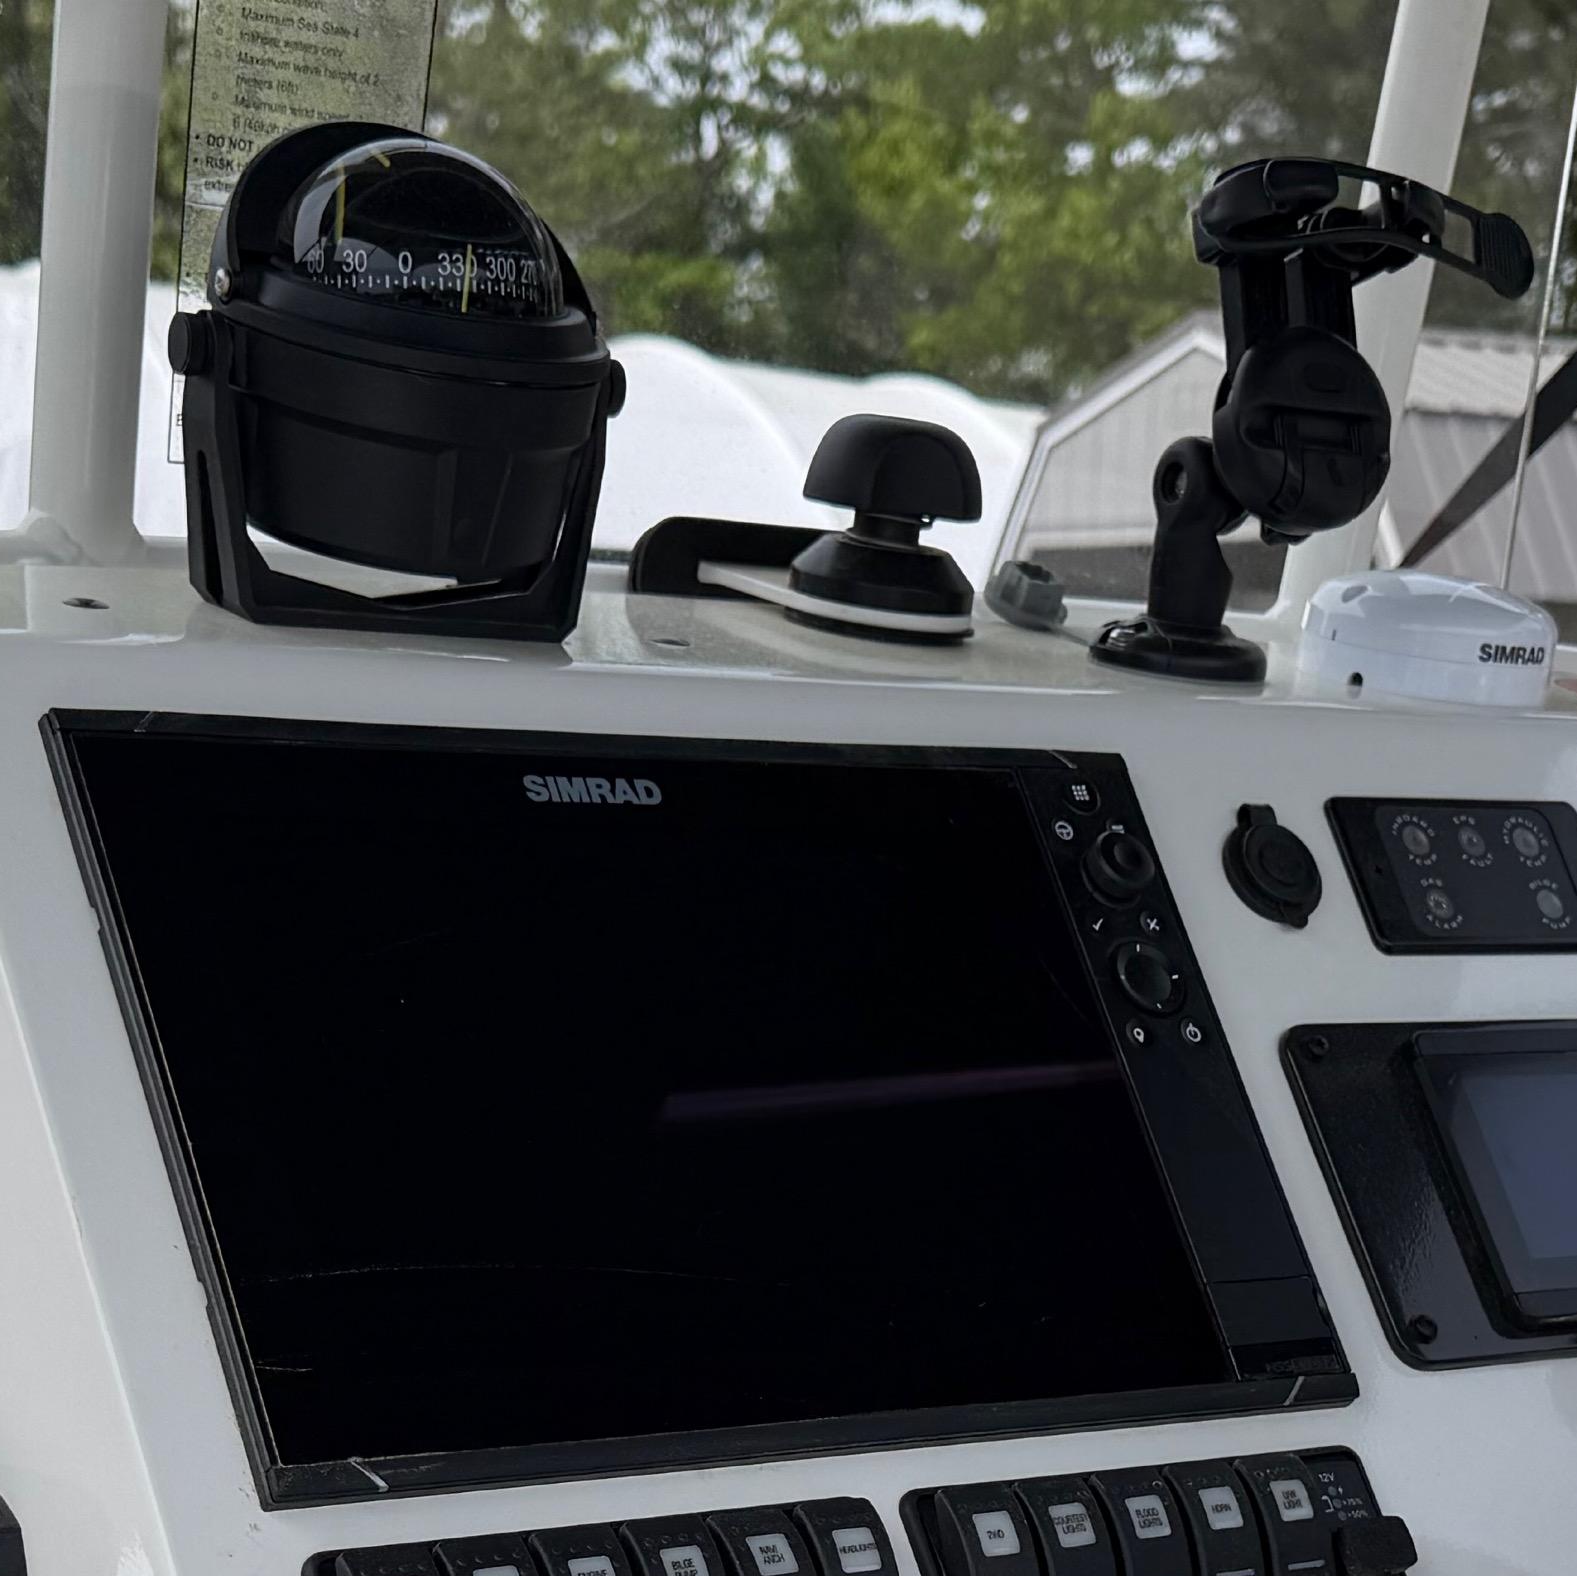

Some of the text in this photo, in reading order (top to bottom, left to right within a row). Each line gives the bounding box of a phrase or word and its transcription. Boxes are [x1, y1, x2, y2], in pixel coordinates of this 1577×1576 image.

[207, 135, 255, 152] DO NOT
[342, 250, 367, 272] 30
[398, 251, 412, 274] 0
[486, 257, 515, 281] 300
[1478, 643, 1545, 665] SIMRAD
[523, 775, 662, 805] SIMRAD
